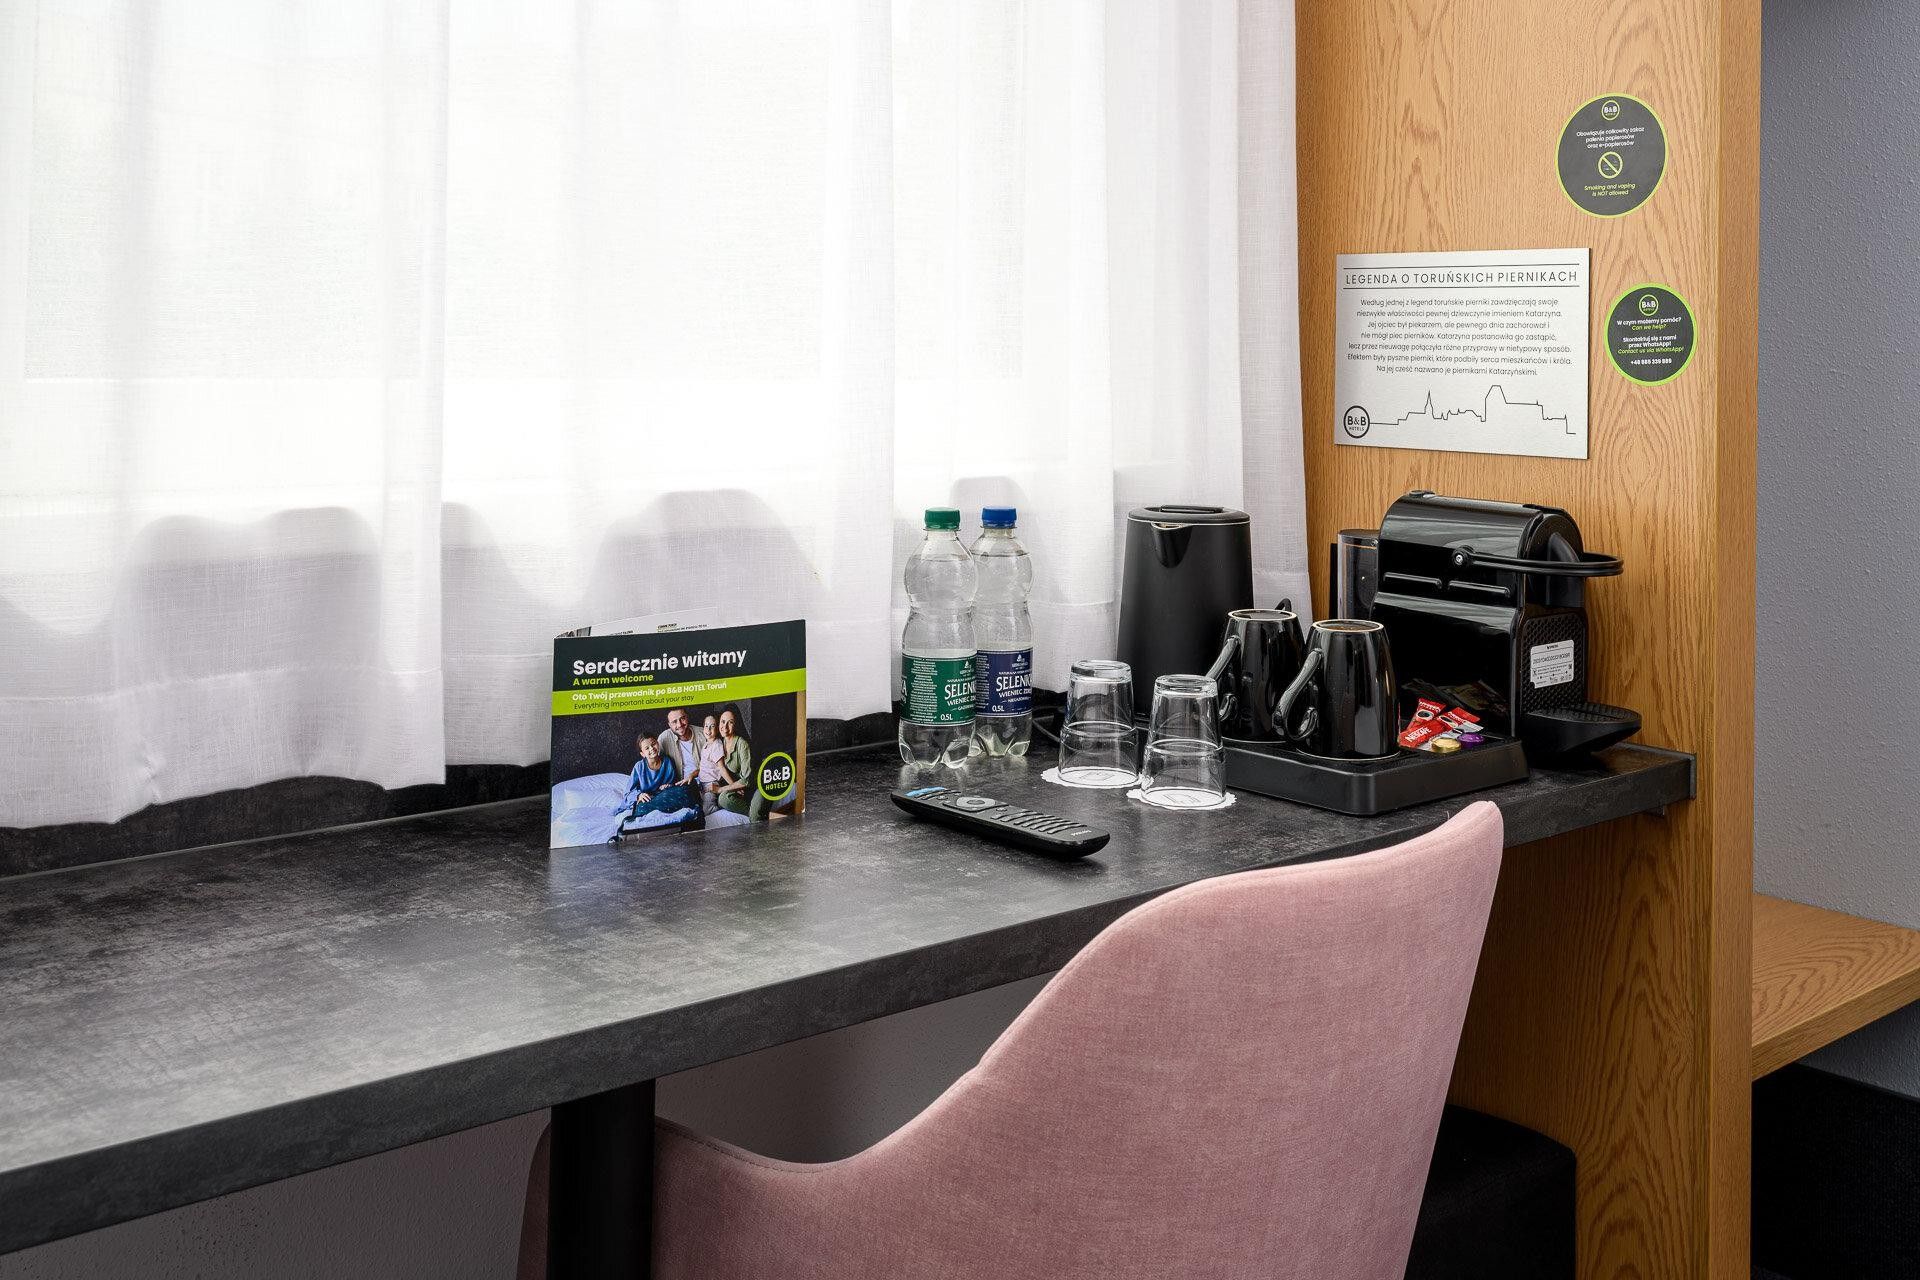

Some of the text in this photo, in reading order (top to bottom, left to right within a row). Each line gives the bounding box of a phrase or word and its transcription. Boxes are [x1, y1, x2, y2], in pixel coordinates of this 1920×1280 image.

[1604, 106, 1618, 114] B&B
[1346, 270, 1576, 284] LEGENDA O TORUŃSKICH PIERNIKACH
[1360, 299, 1384, 307] Według
[1385, 299, 1405, 307] jednej
[1410, 299, 1432, 307] legend
[1466, 298, 1490, 306] pierniki
[1491, 298, 1536, 306] zawdzięczają
[1452, 367, 1487, 375] piernikami
[1489, 368, 1537, 376] Katarzyńskimi.
[1348, 416, 1366, 426] B&B
[573, 650, 747, 676] Serdecznie witamy
[612, 674, 654, 684] welcome
[589, 692, 608, 701] Twój
[609, 688, 654, 701] przewodnik
[656, 688, 666, 697] po
[667, 686, 682, 694] B&B
[683, 684, 706, 692] HOTEL
[707, 682, 727, 691] Toruń
[998, 688, 1022, 698] WIENIEC
[574, 701, 610, 710] Everything
[611, 700, 644, 709] important
[666, 697, 680, 706] your
[681, 695, 695, 703] stay
[947, 697, 969, 706] WIENIEC
[764, 766, 790, 784] B&B
[766, 782, 788, 790] HOTELS
